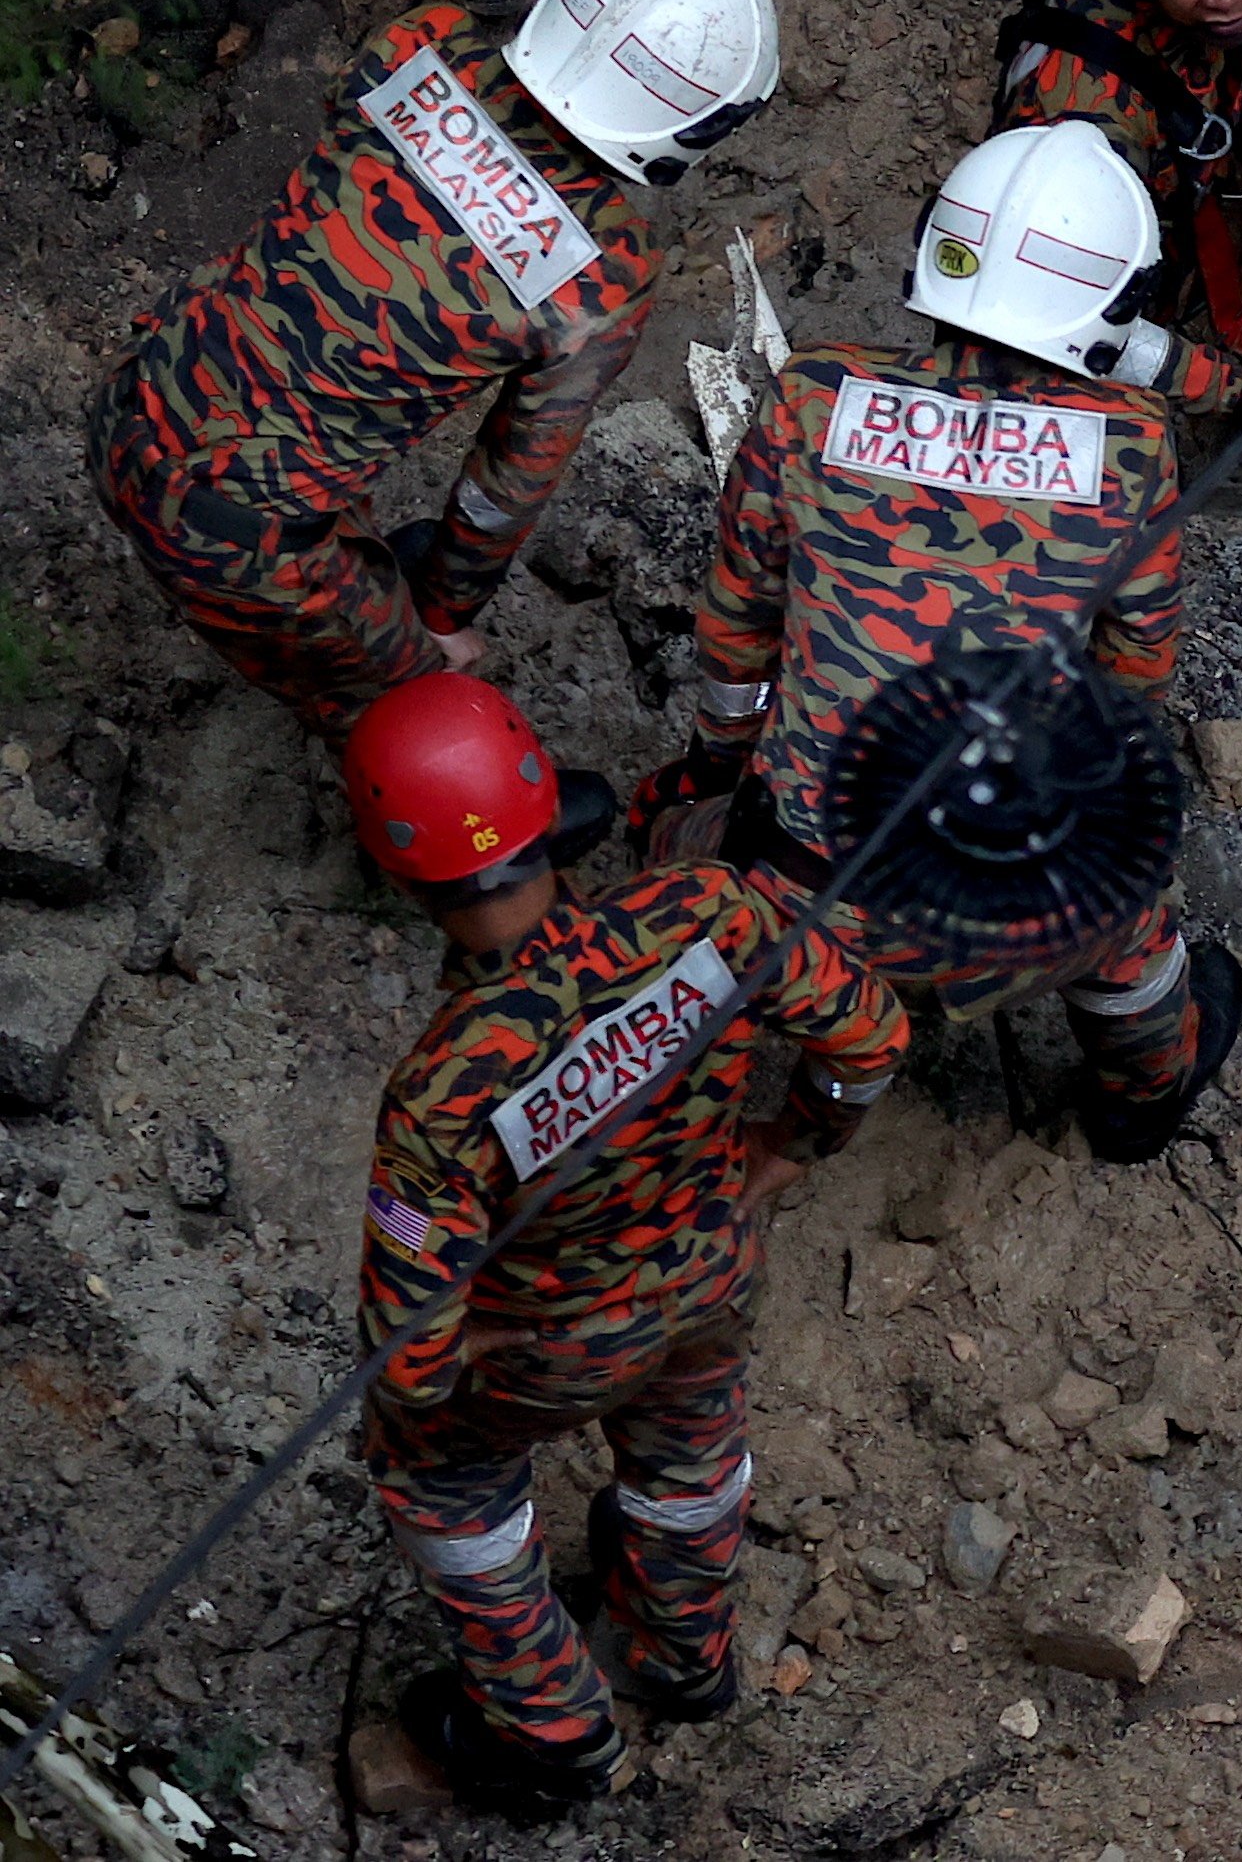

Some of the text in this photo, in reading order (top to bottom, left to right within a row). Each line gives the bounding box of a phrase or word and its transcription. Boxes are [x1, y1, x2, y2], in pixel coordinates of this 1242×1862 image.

[384, 101, 534, 281] MALAYSIA
[408, 70, 565, 258] BOMBA
[845, 429, 1078, 494] MALAYSIA
[863, 392, 1071, 459] BOMBA
[521, 977, 708, 1133] BOMBA
